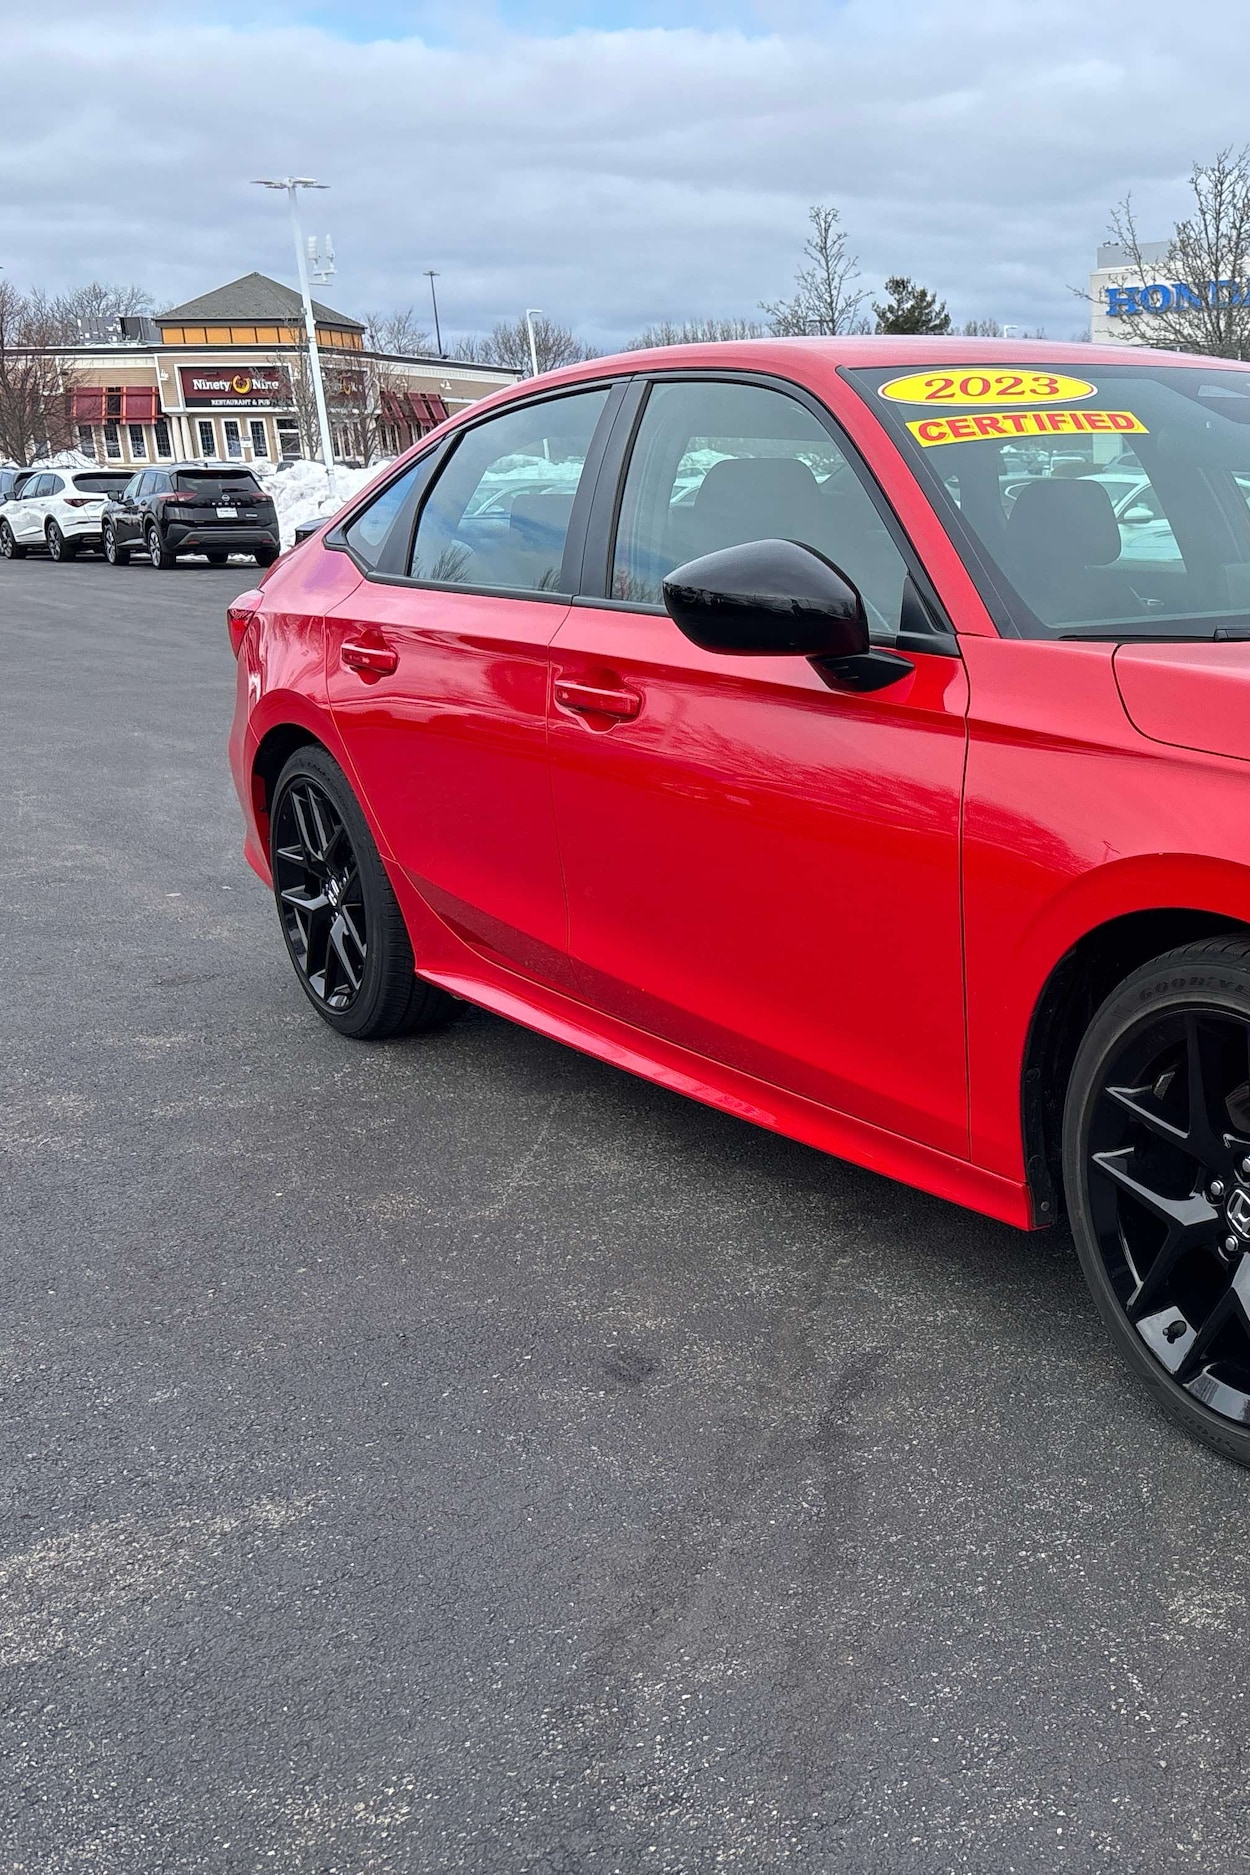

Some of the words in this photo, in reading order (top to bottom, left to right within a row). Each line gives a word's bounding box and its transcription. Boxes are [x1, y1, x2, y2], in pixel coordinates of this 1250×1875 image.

[193, 378, 231, 392] Ninety
[251, 378, 279, 390] Nine
[924, 376, 1060, 400] 2023
[917, 413, 1137, 442] CERTIFIED
